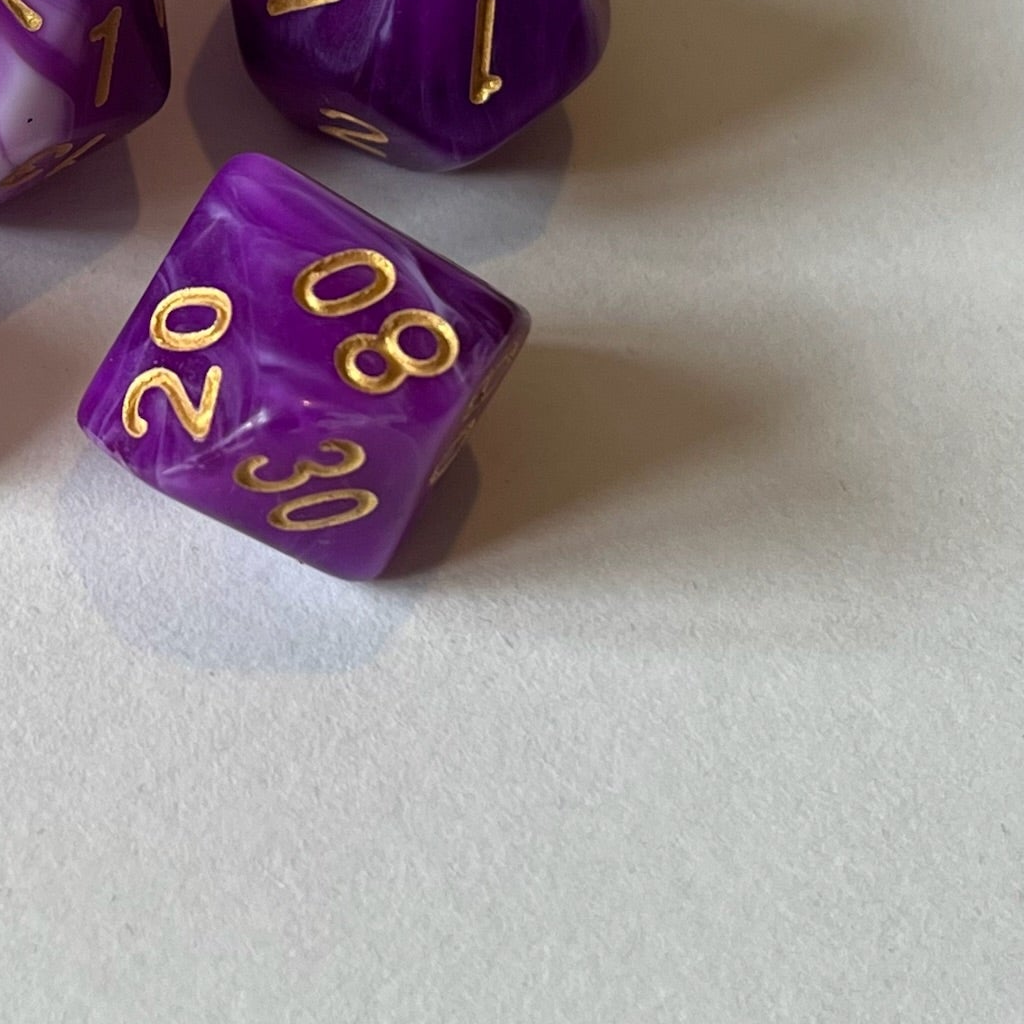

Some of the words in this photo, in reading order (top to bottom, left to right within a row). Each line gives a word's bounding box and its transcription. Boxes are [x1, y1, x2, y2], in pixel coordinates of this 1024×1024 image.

[89, 6, 122, 107] 1
[121, 286, 233, 442] 20
[292, 248, 460, 396] 80
[232, 438, 379, 532] 30
